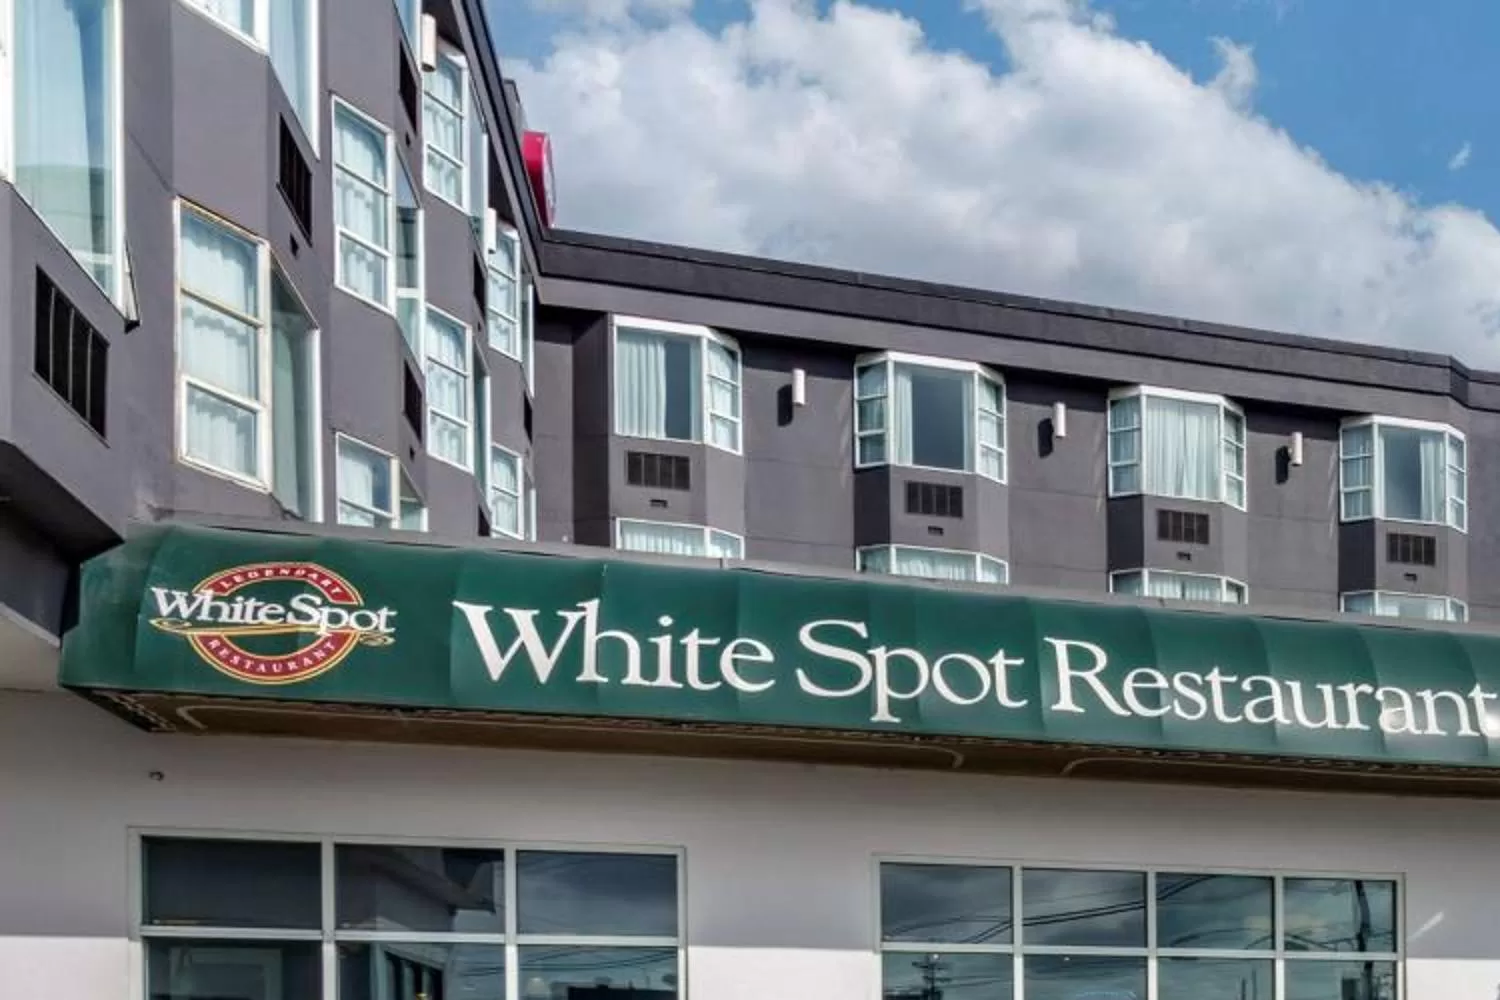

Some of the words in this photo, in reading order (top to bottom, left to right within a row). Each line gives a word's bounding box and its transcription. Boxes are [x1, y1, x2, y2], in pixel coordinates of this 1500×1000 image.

[207, 638, 336, 674] RESTAURANT
[452, 598, 776, 693] White
[795, 619, 1029, 724] Spot
